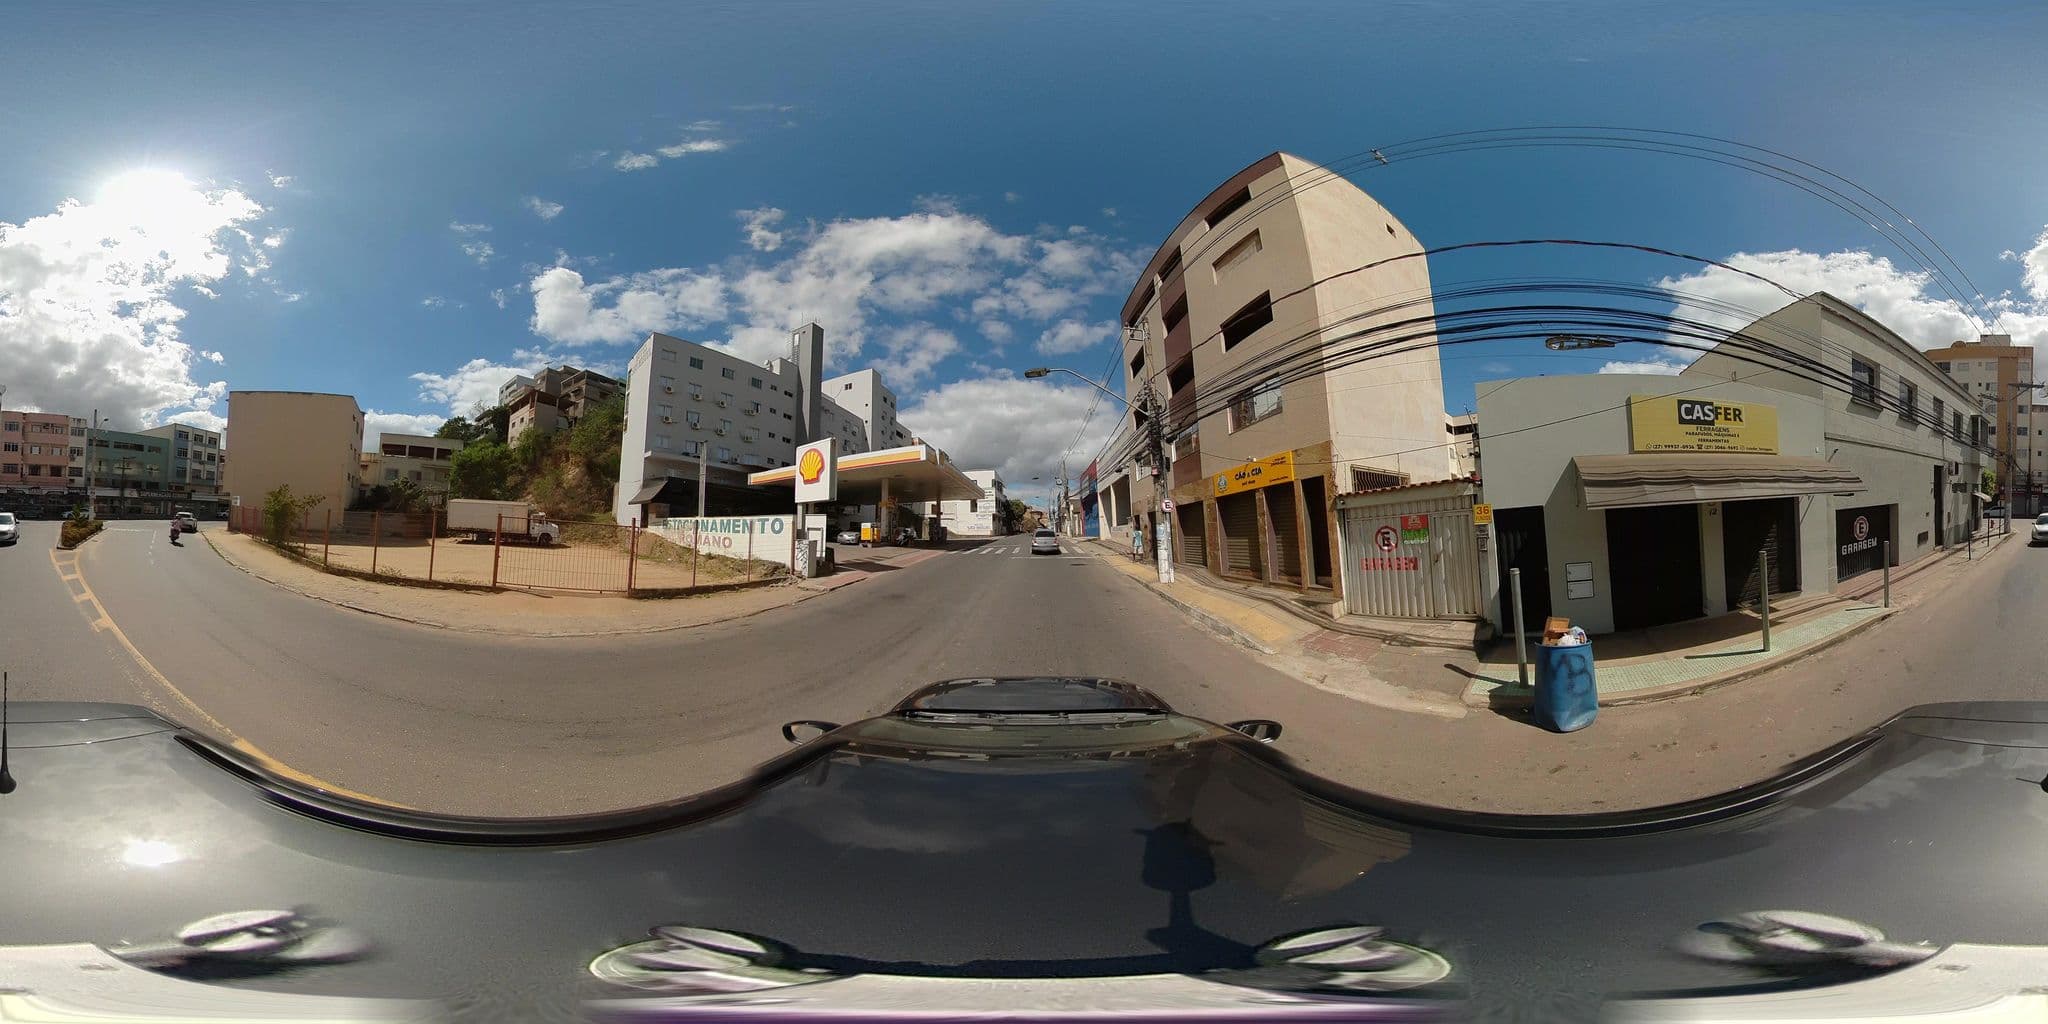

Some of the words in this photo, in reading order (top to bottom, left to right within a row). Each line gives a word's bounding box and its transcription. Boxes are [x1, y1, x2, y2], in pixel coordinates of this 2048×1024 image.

[1681, 403, 1744, 422] CASFER
[1476, 505, 1490, 515] 36
[1841, 537, 1877, 556] GARAGEM
[1361, 558, 1418, 570] GARAGEM
